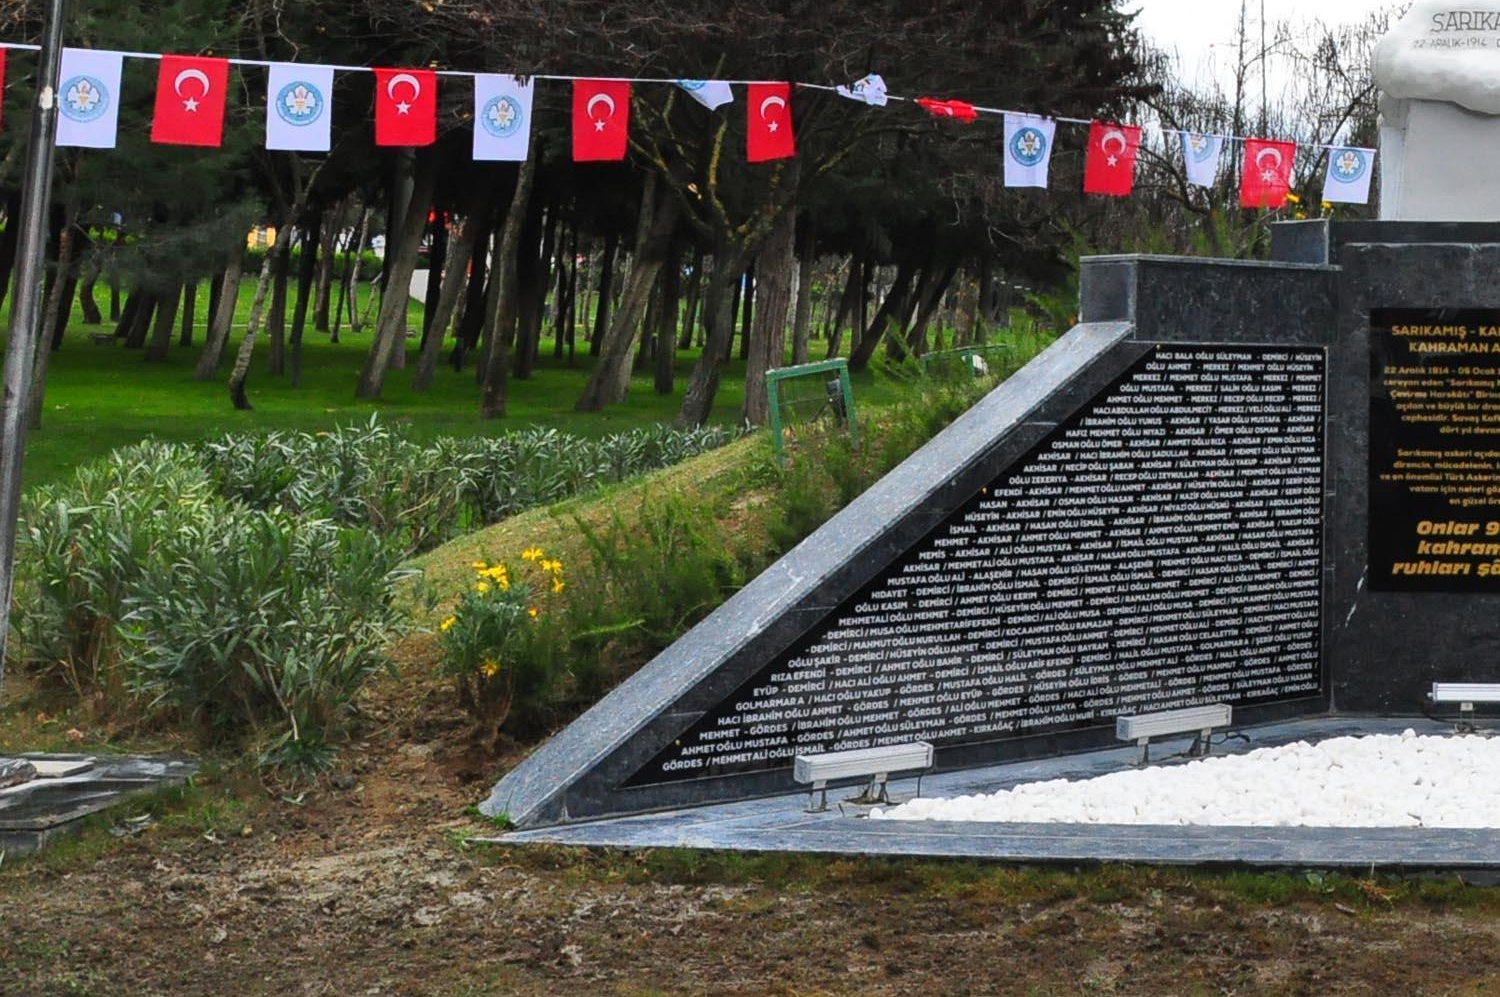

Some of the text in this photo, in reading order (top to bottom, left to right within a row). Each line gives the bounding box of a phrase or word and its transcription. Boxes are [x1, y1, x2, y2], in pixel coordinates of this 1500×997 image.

[1391, 326, 1467, 340] SARIKAMIŞ
[1409, 342, 1488, 353] KAHRAMAN
[1416, 520, 1479, 536] Onlar
[1392, 561, 1470, 575] ruhları
[771, 671, 826, 682] RIZA EFENDİ
[753, 683, 825, 696] EYÜP DEMİRCİ
[718, 706, 842, 725] HACI İBRAHİM OĞLU AHMET
[700, 724, 787, 740] MEHMET GÖRDES
[681, 731, 834, 755] AHMET OĞLU MUSTAFA GÖRDES
[663, 759, 702, 771] GÖRDES
